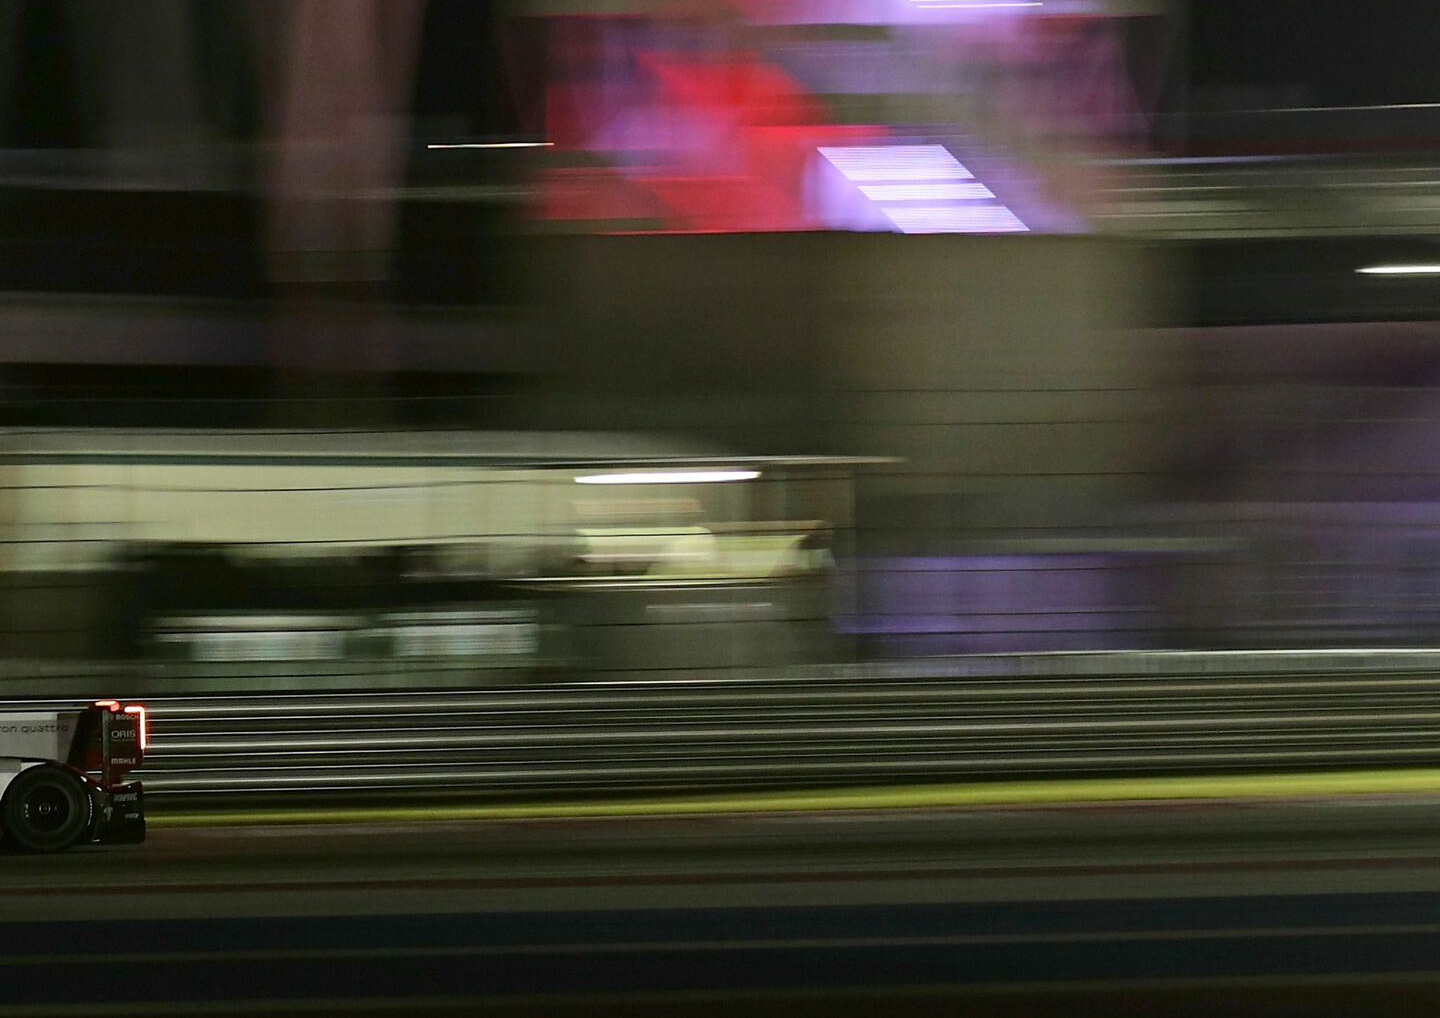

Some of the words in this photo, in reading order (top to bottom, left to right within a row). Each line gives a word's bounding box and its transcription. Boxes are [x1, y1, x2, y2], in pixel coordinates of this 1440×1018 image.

[21, 724, 69, 734] quattro
[111, 730, 137, 738] ORIS
[111, 757, 137, 765] MAHLE
